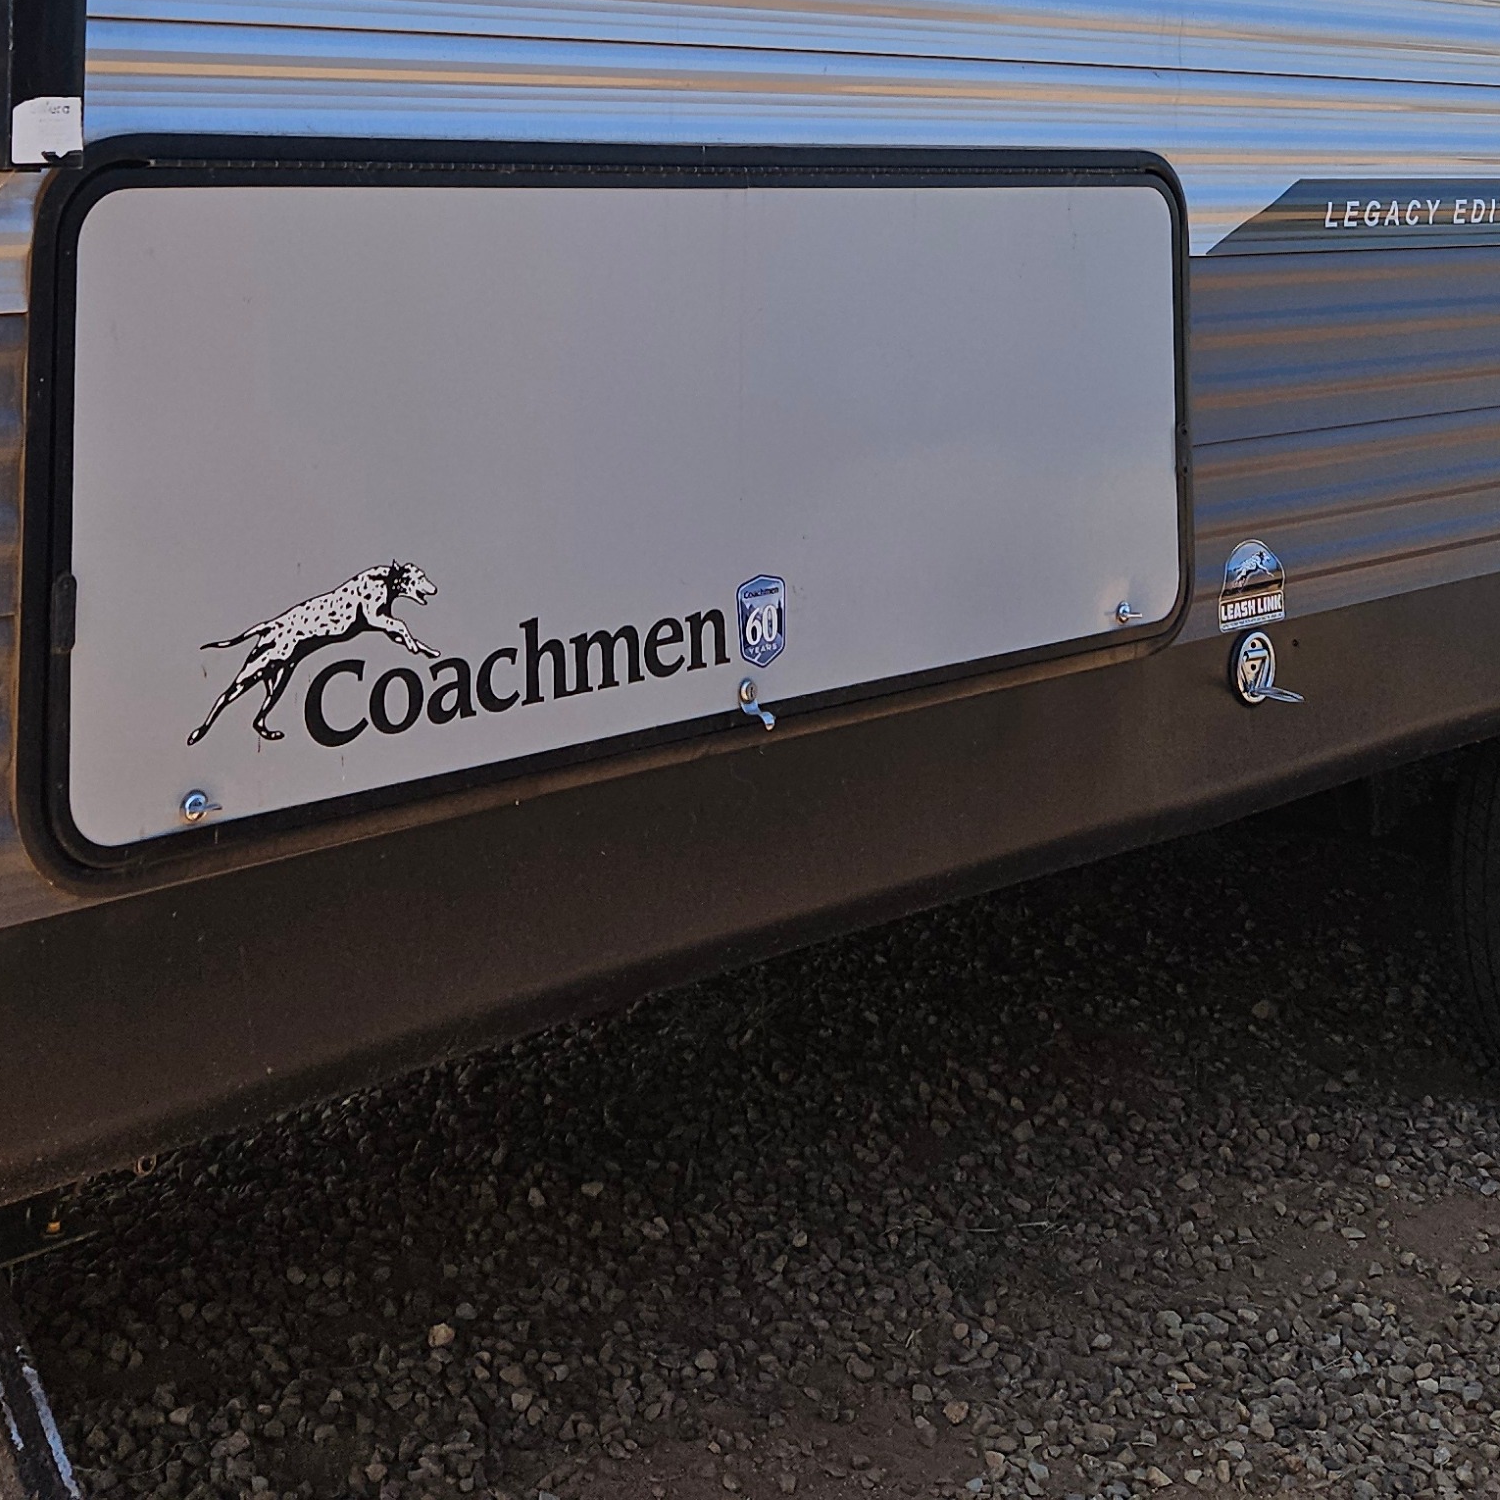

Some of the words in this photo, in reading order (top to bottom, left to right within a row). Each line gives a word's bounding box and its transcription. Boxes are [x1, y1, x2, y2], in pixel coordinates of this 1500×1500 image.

[1324, 200, 1441, 228] LEGACY
[743, 587, 779, 599] Coachmen
[1221, 599, 1256, 621] LEASH
[1257, 593, 1282, 614] LINK
[746, 604, 778, 646] 60
[749, 643, 777, 655] YEARS
[304, 607, 730, 747] Coachmen
